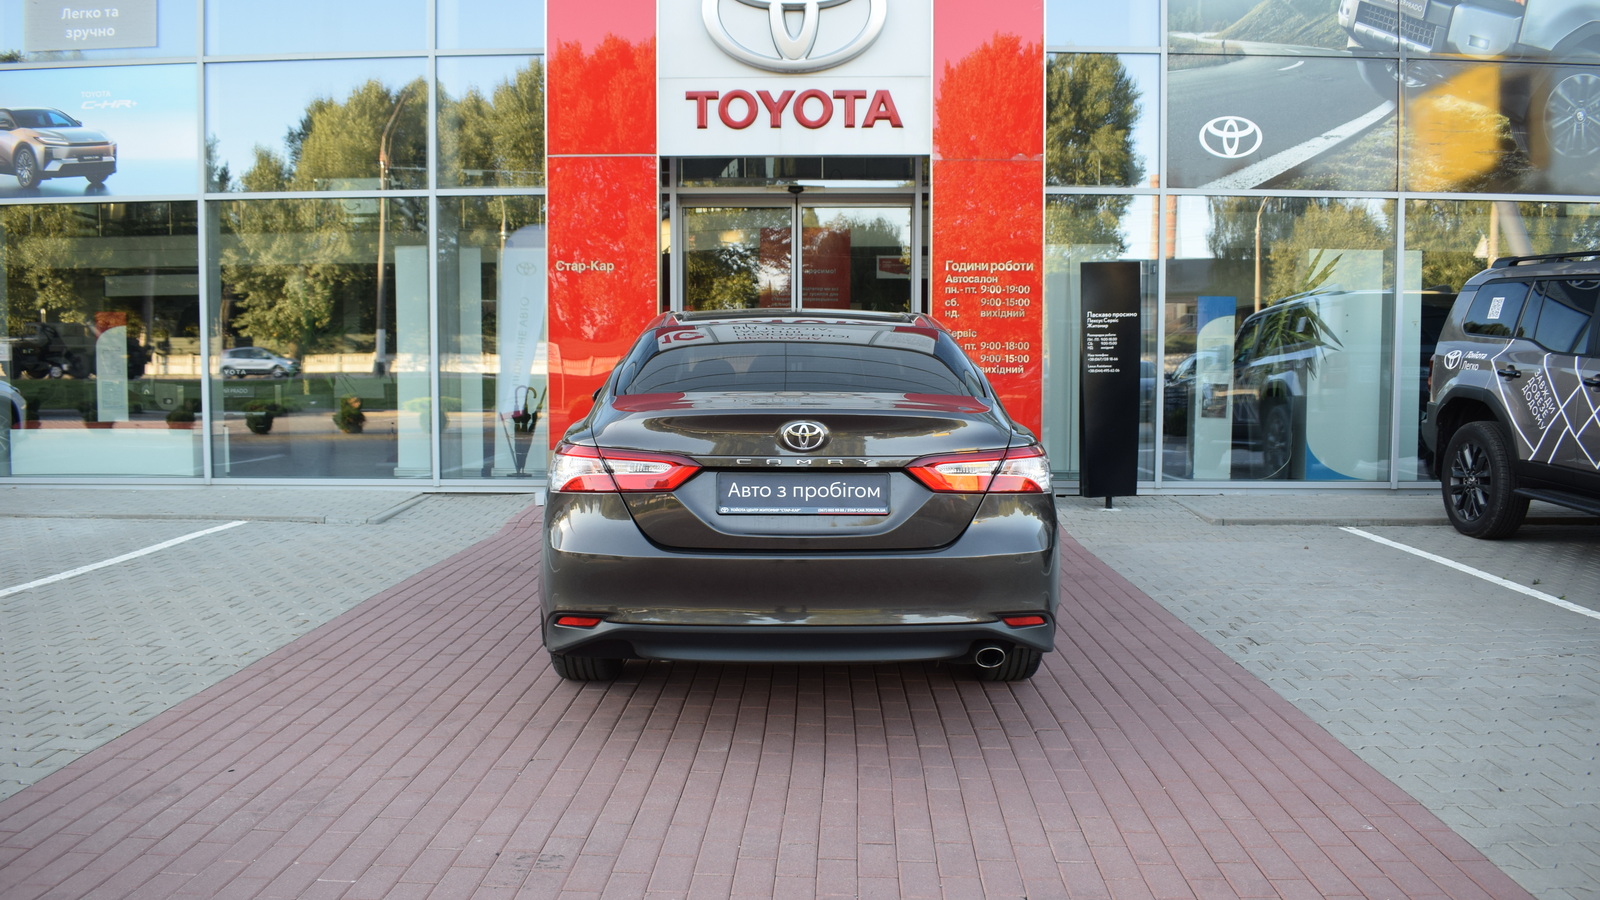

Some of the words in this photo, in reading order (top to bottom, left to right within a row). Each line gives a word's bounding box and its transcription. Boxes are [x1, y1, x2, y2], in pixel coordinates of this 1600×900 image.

[61, 8, 101, 20] Легко
[104, 7, 119, 18] та
[65, 27, 116, 41] зручно
[685, 88, 904, 130] TOYOTA
[555, 260, 615, 273] Стар-Кар
[945, 260, 989, 272] Години
[990, 260, 1034, 274] роботи
[945, 274, 998, 283] Автосалон
[980, 285, 1031, 294] 9:00-19:00
[945, 298, 959, 307] сб.
[980, 298, 1031, 307] 9:00-15:00
[945, 310, 960, 319] нд.
[980, 309, 1025, 319] вихідний
[980, 341, 1030, 350] 9:00-18:00
[980, 354, 1030, 363] 9:00-15:00
[1461, 360, 1480, 371] Легко
[1527, 376, 1549, 419] ДОВЕЗЕ
[1533, 368, 1556, 415] ЗАВЖДИ
[1521, 386, 1547, 430] ДОДОМУ
[727, 482, 772, 498] Авто
[776, 486, 787, 498] з
[793, 481, 880, 502] пробігом
